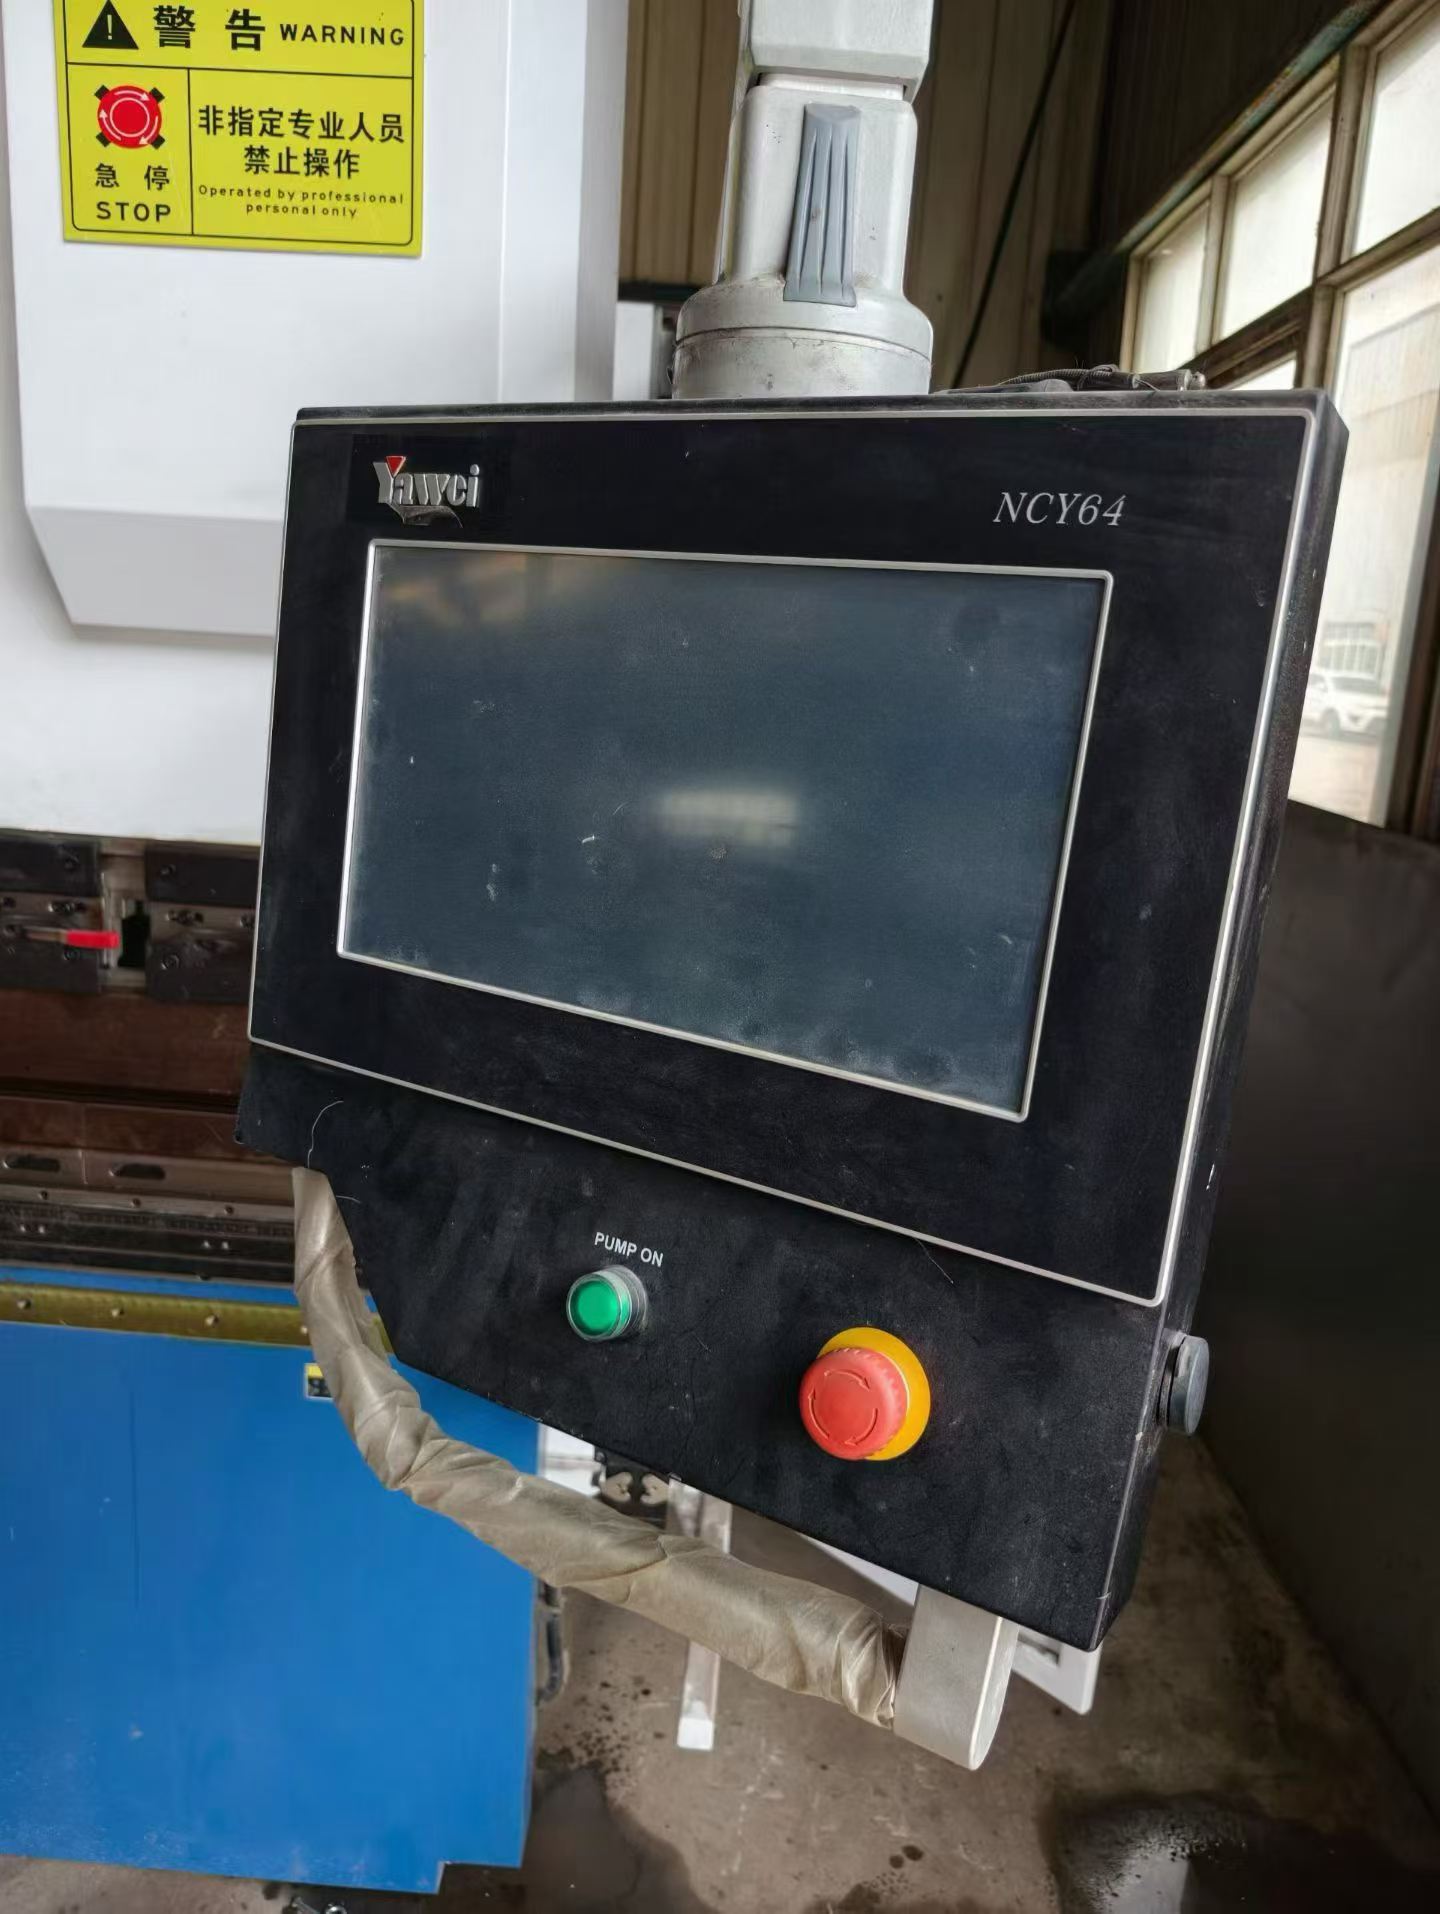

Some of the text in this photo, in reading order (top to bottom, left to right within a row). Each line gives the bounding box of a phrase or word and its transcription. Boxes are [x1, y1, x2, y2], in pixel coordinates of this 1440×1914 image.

[280, 24, 405, 46] WARNING
[198, 105, 405, 144] 非指定专业人员
[244, 145, 360, 179] 禁止操作
[198, 184, 404, 204] Operated by professional
[96, 201, 171, 223] STOP
[246, 203, 357, 219] personal only
[992, 491, 1127, 526] NCY64
[594, 1231, 664, 1268] PUMP ON
